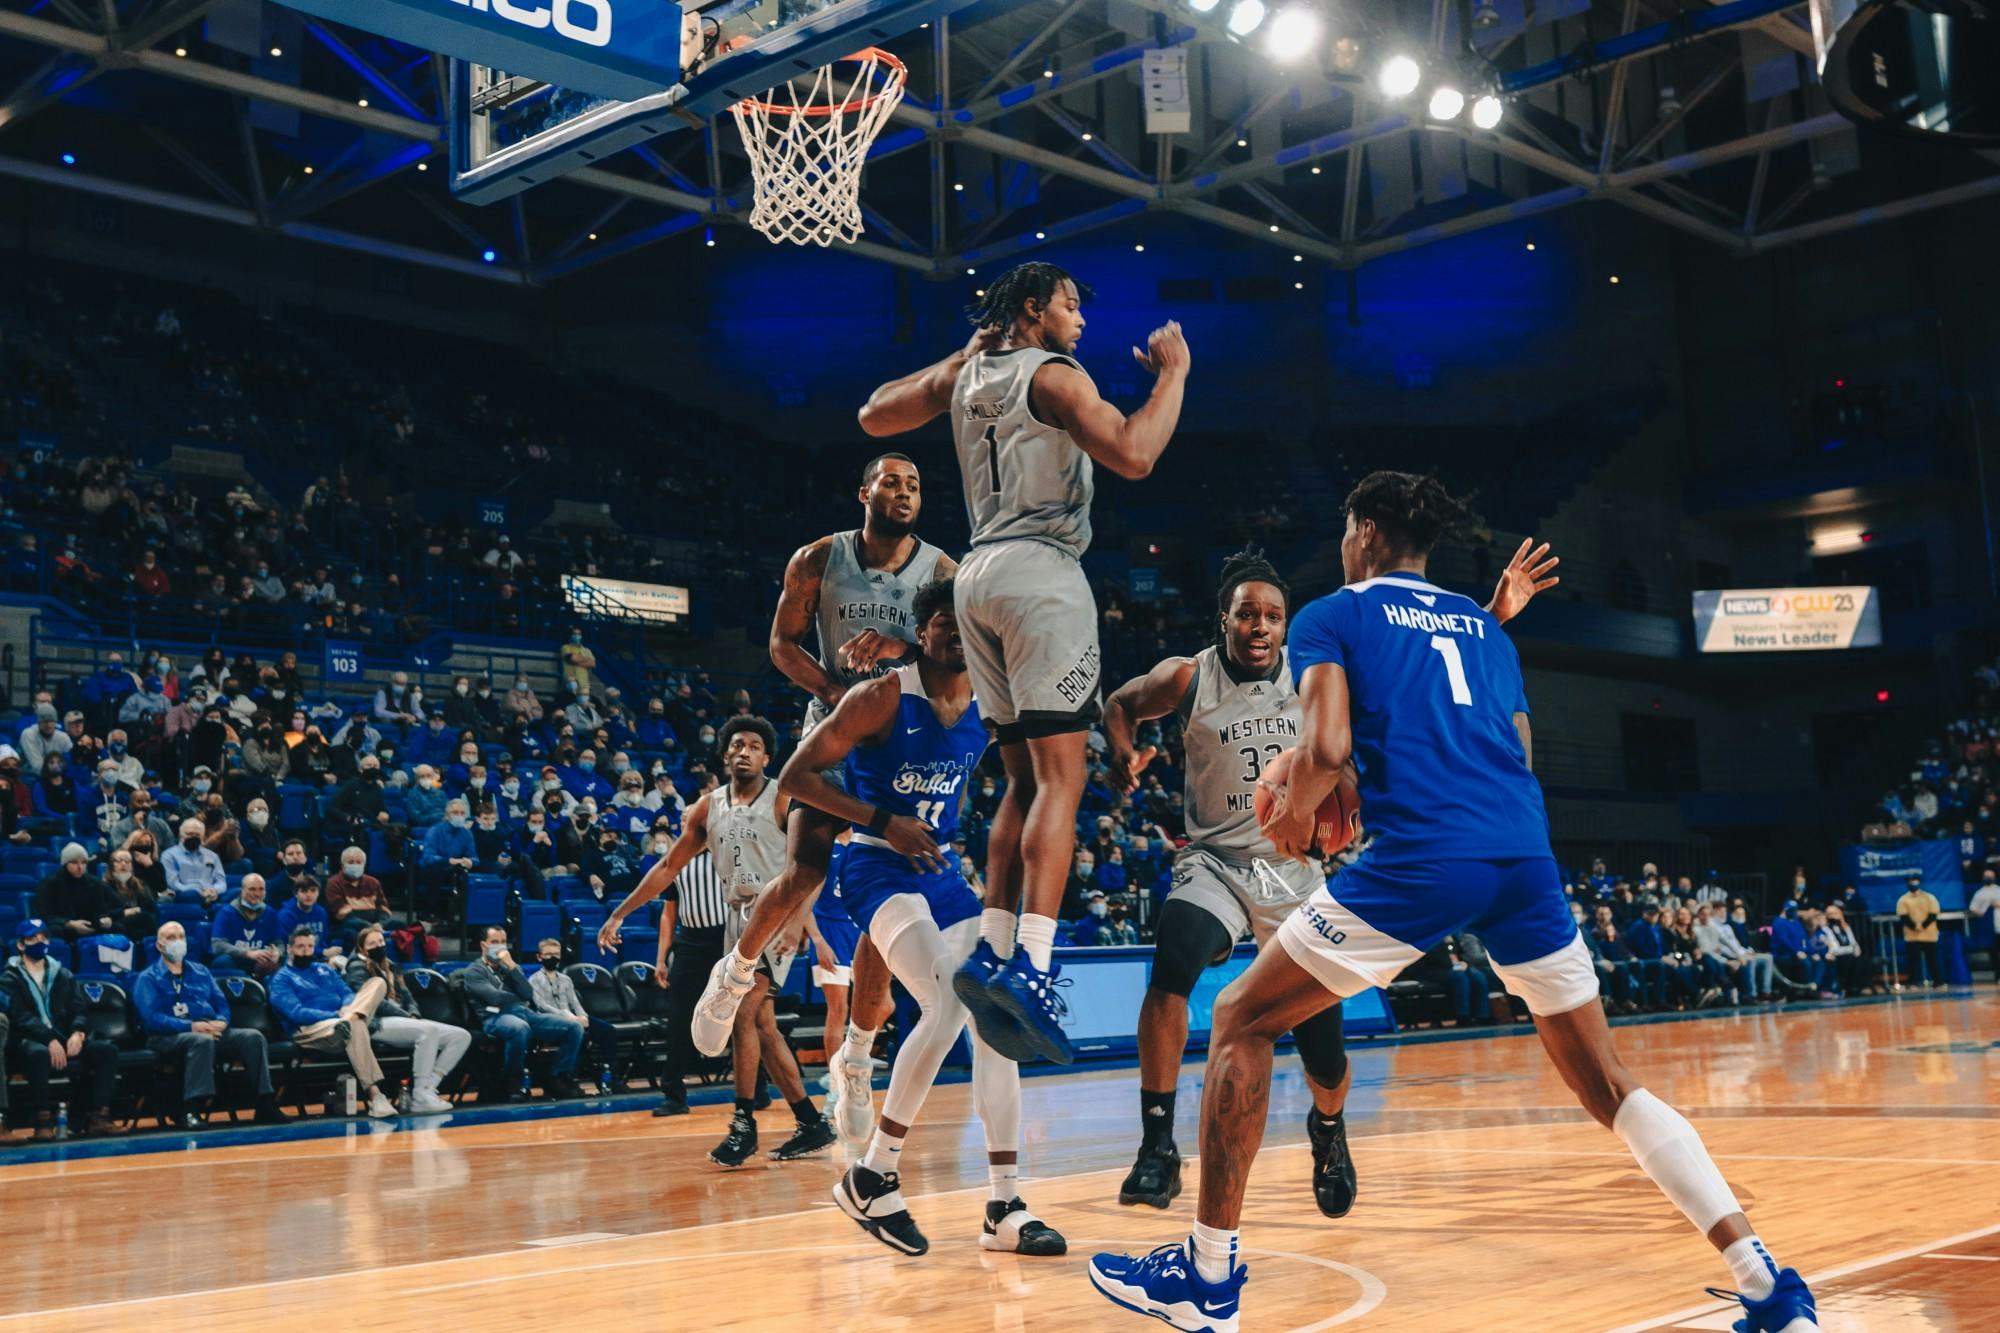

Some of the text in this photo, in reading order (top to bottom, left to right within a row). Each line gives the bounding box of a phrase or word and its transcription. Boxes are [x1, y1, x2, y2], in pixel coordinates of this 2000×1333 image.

[983, 424, 1002, 493] 1
[483, 509, 504, 524] 205
[838, 602, 908, 628] WESTERN
[1726, 600, 1769, 614] NEWS
[1835, 594, 1855, 612] 23
[1382, 603, 1485, 640] HARDNETT
[1734, 631, 1839, 646] News Leader
[332, 657, 358, 673] 103
[1430, 634, 1473, 707] 1
[1219, 717, 1298, 745] WESTERN
[915, 800, 945, 829] 11
[733, 844, 742, 868] 2
